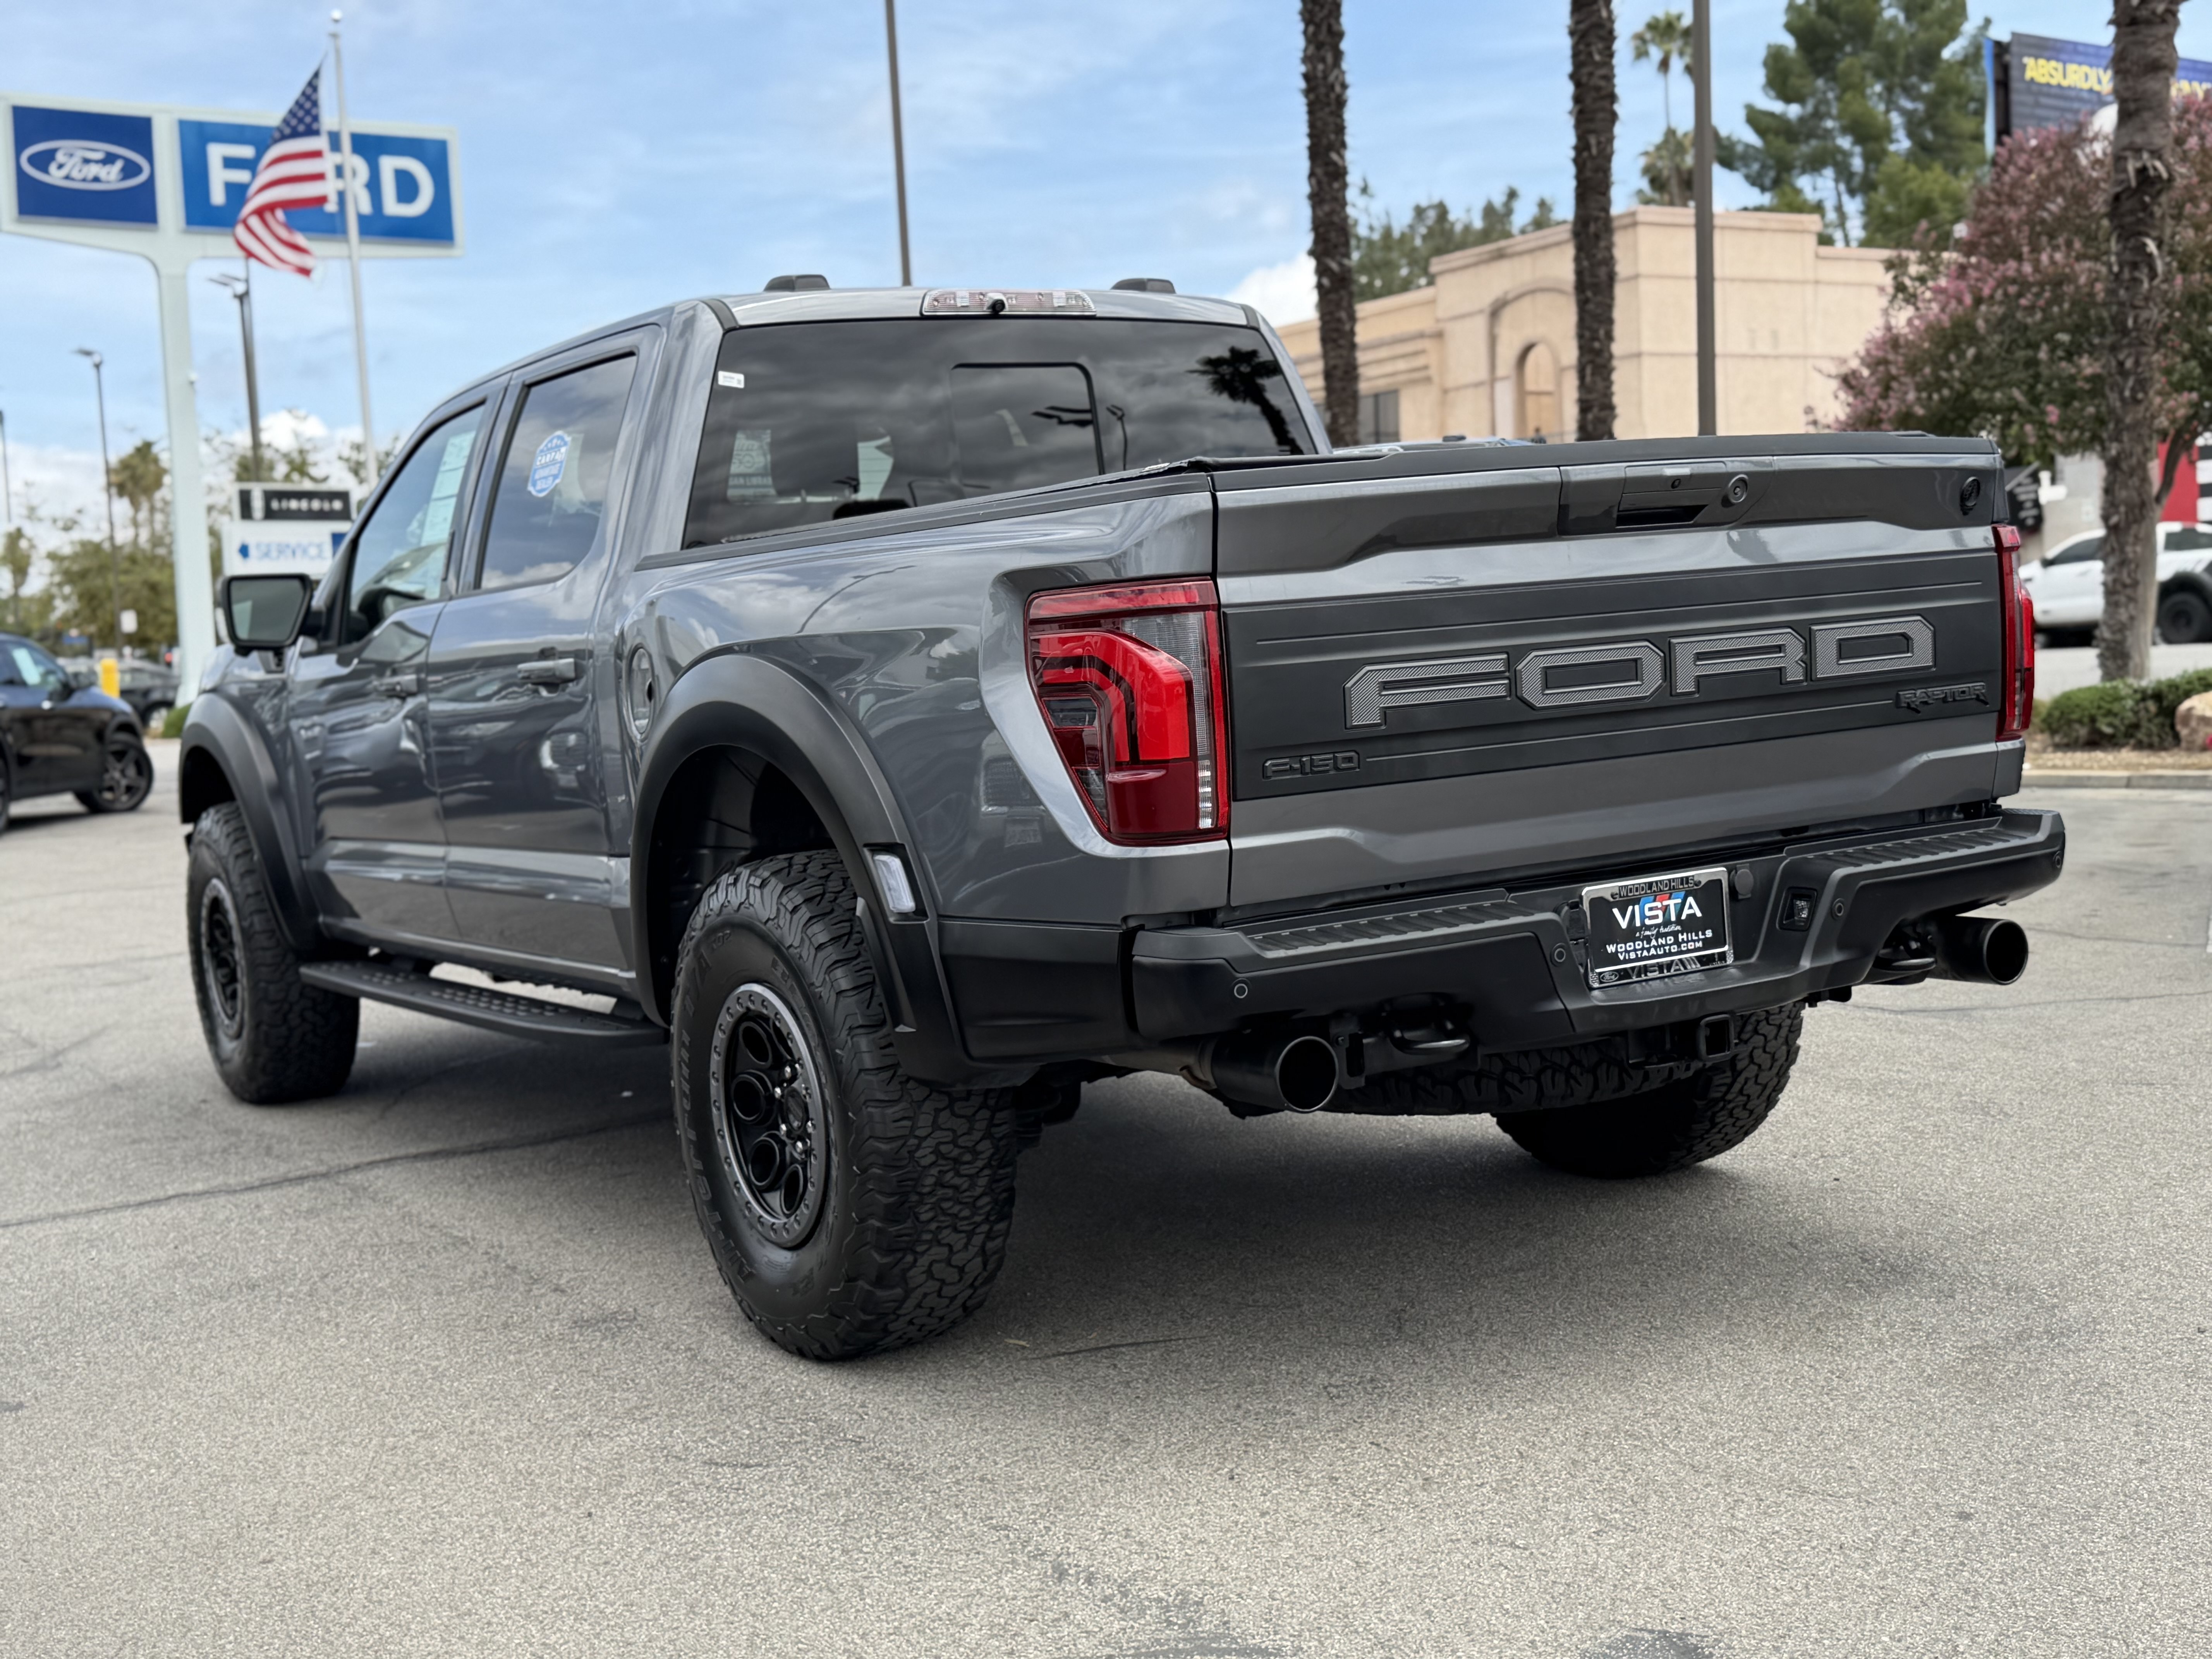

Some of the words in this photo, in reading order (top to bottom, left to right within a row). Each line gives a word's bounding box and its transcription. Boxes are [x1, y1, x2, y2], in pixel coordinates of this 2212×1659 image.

[48, 147, 125, 182] Ford
[206, 142, 434, 218] FRD
[1342, 615, 1936, 730] FORD
[1896, 682, 1989, 714] RAPTOR
[1262, 750, 1360, 780] F-150
[1619, 879, 1669, 897] WOODLAND
[1671, 876, 1694, 889] HILLS
[1612, 896, 1702, 929] VISTA
[1606, 936, 1674, 954] WOODLAND
[1678, 929, 1713, 942] HILLS
[1627, 959, 1685, 979] VISTA
